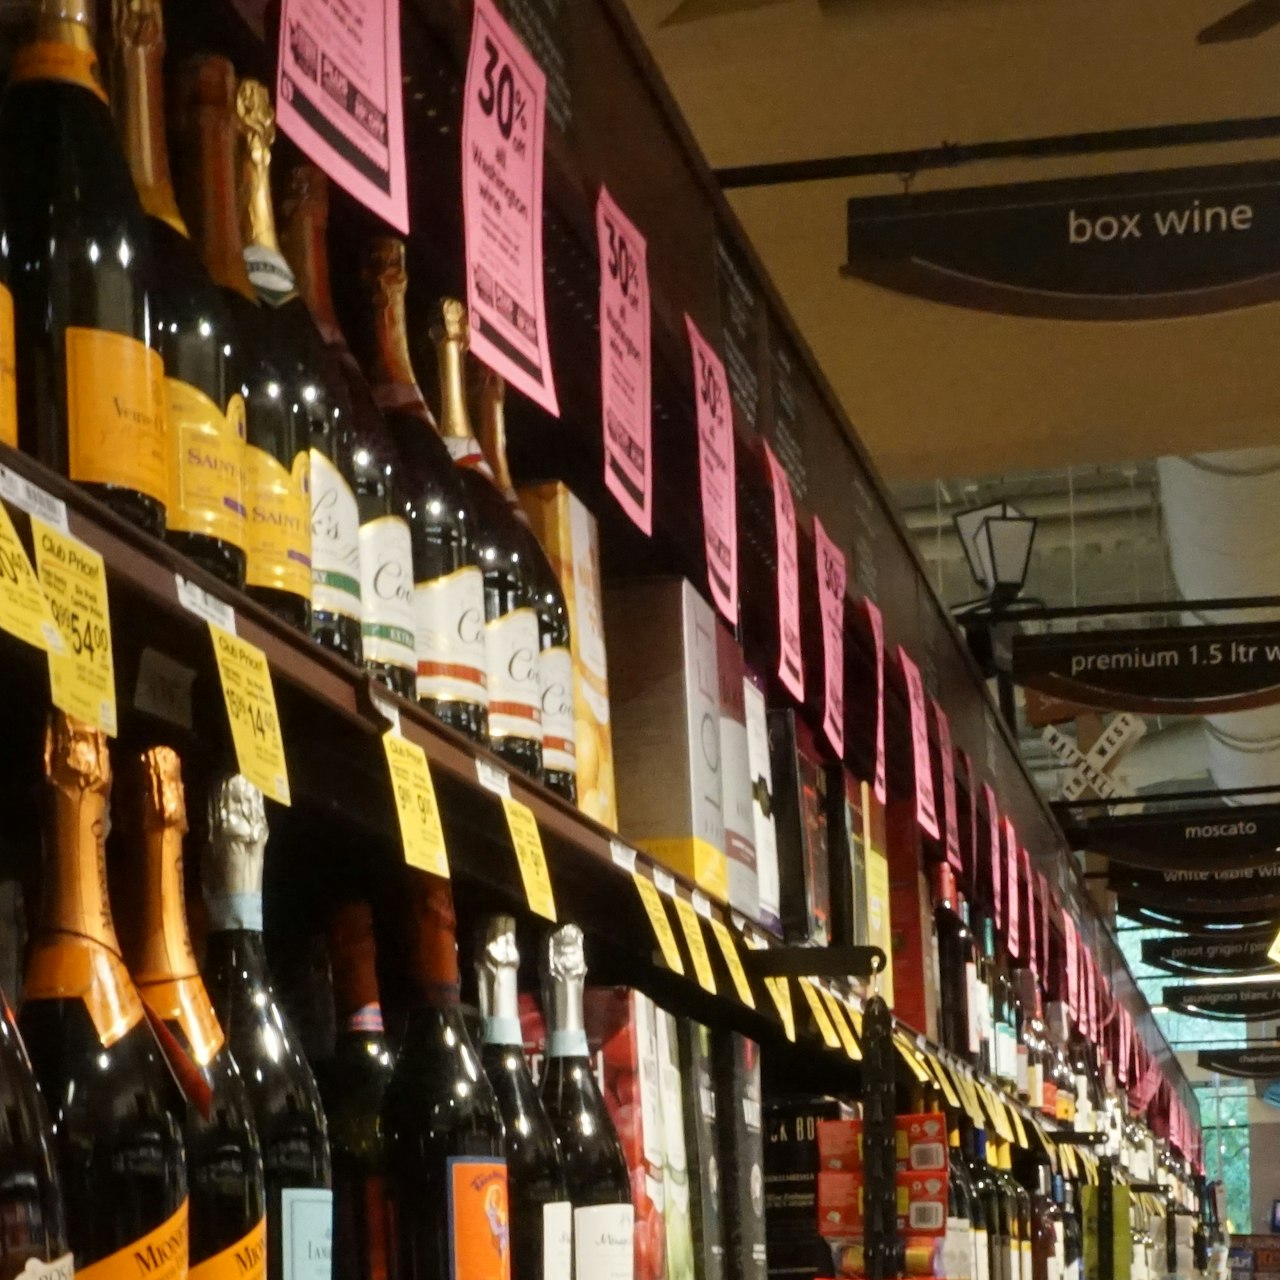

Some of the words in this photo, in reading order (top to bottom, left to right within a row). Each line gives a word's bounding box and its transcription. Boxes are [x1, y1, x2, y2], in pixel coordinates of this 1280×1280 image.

[470, 137, 529, 220] Washington
[1067, 208, 1142, 245] box
[1155, 200, 1254, 236] wine
[41, 534, 67, 559] Club
[68, 550, 99, 579] Price!
[1071, 647, 1179, 677] premium
[1188, 643, 1222, 666] 1.5
[1230, 640, 1256, 664] ltr
[1096, 716, 1131, 758] WEST
[1184, 819, 1257, 839] moscato
